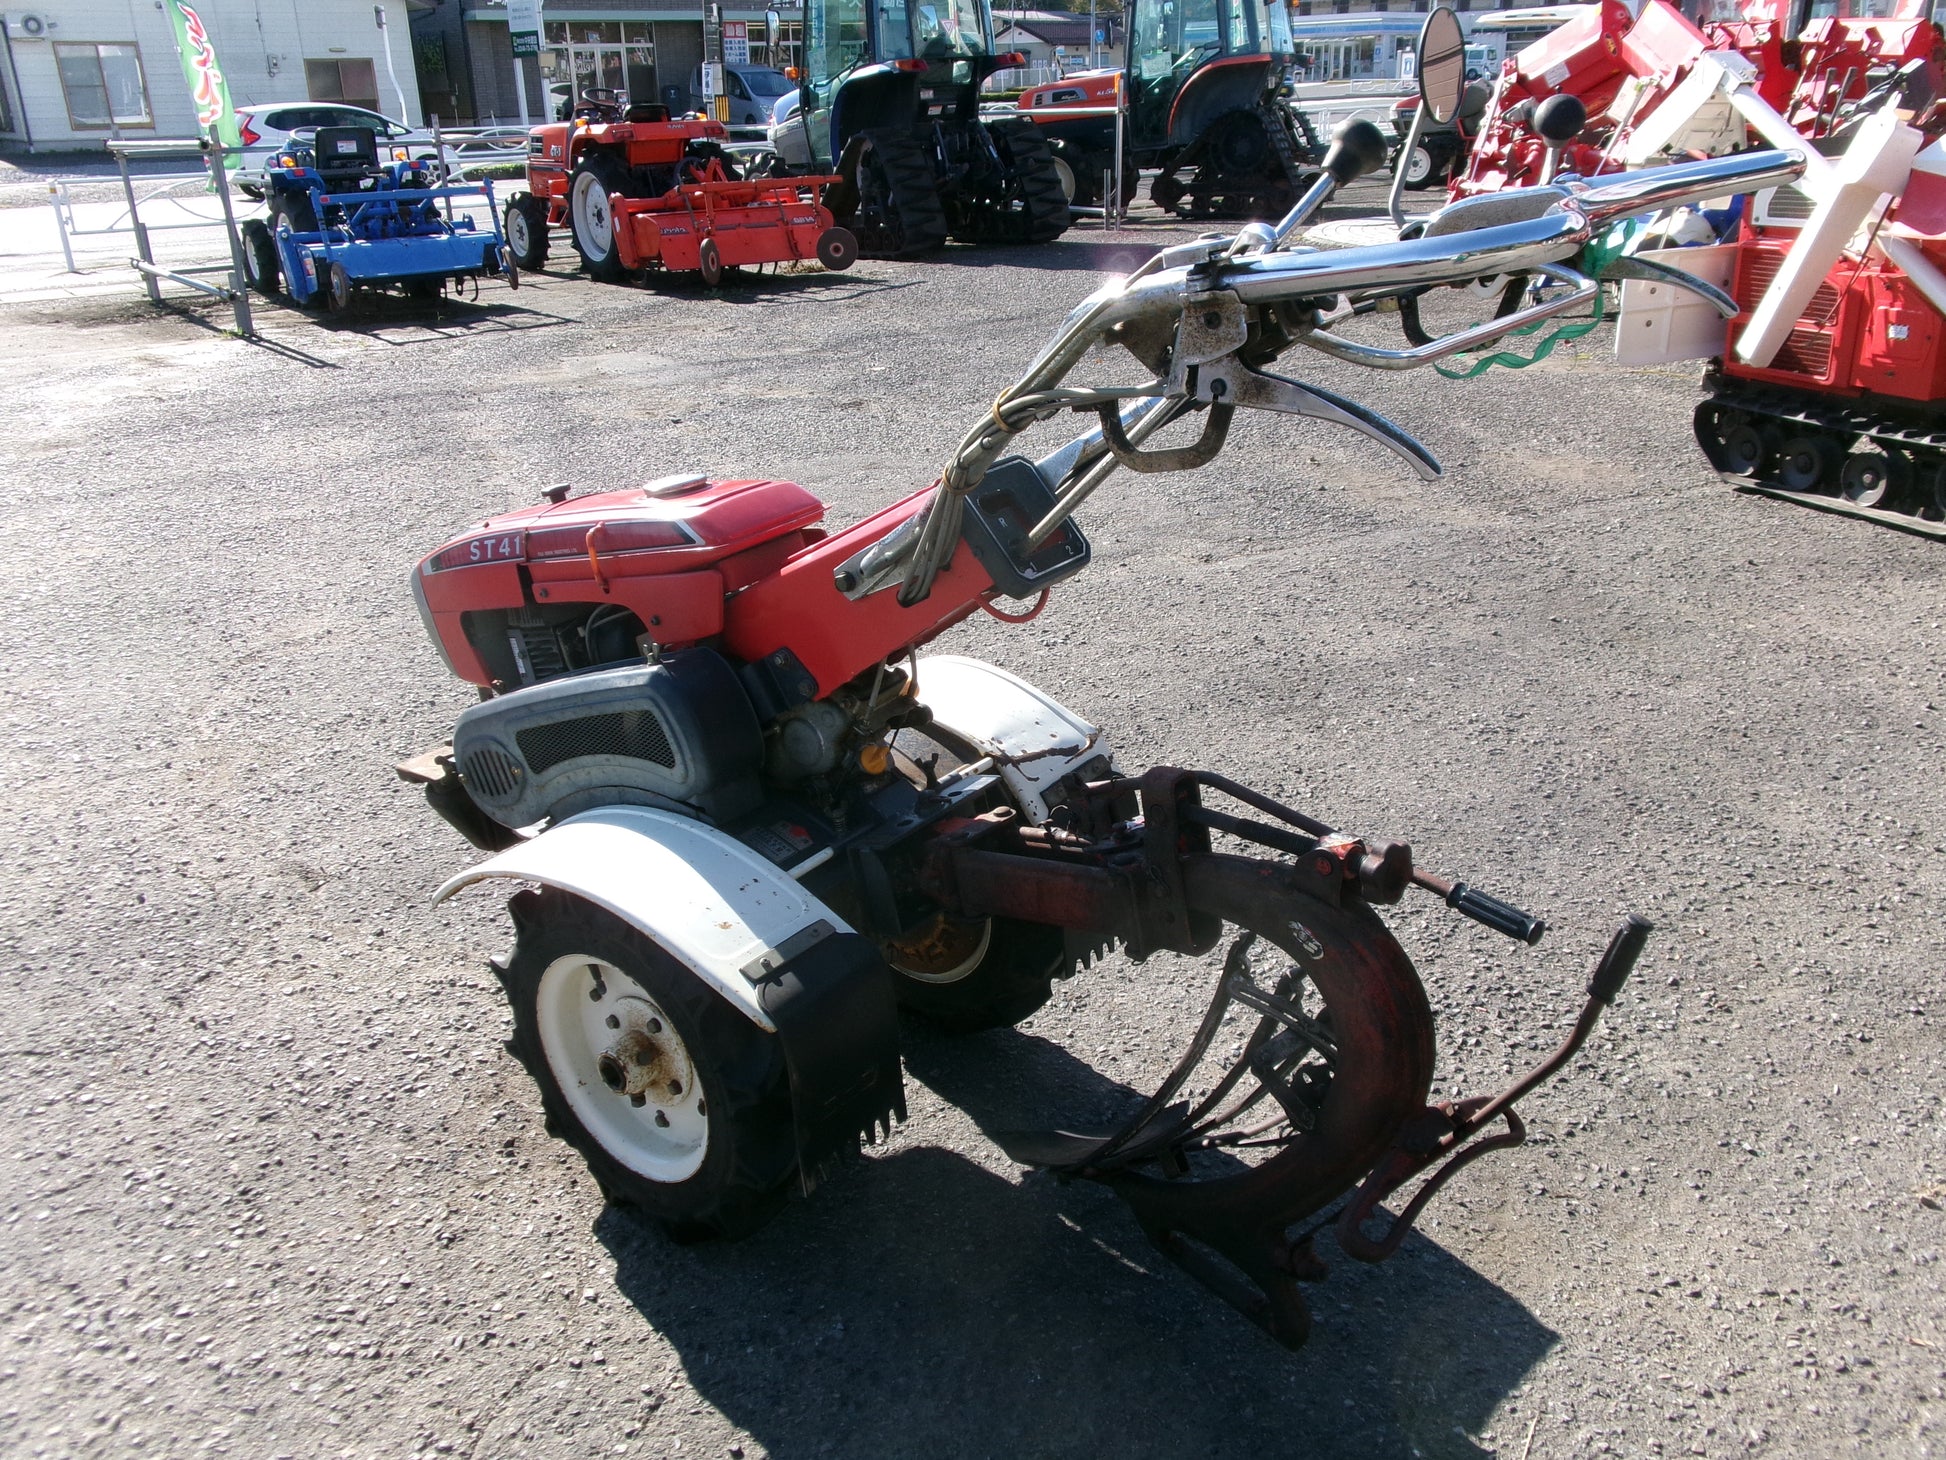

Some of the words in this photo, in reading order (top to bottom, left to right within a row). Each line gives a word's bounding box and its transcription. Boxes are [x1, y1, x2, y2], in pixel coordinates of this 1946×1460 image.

[998, 517, 1008, 528] R
[470, 535, 521, 561] ST41
[1065, 545, 1074, 555] 2
